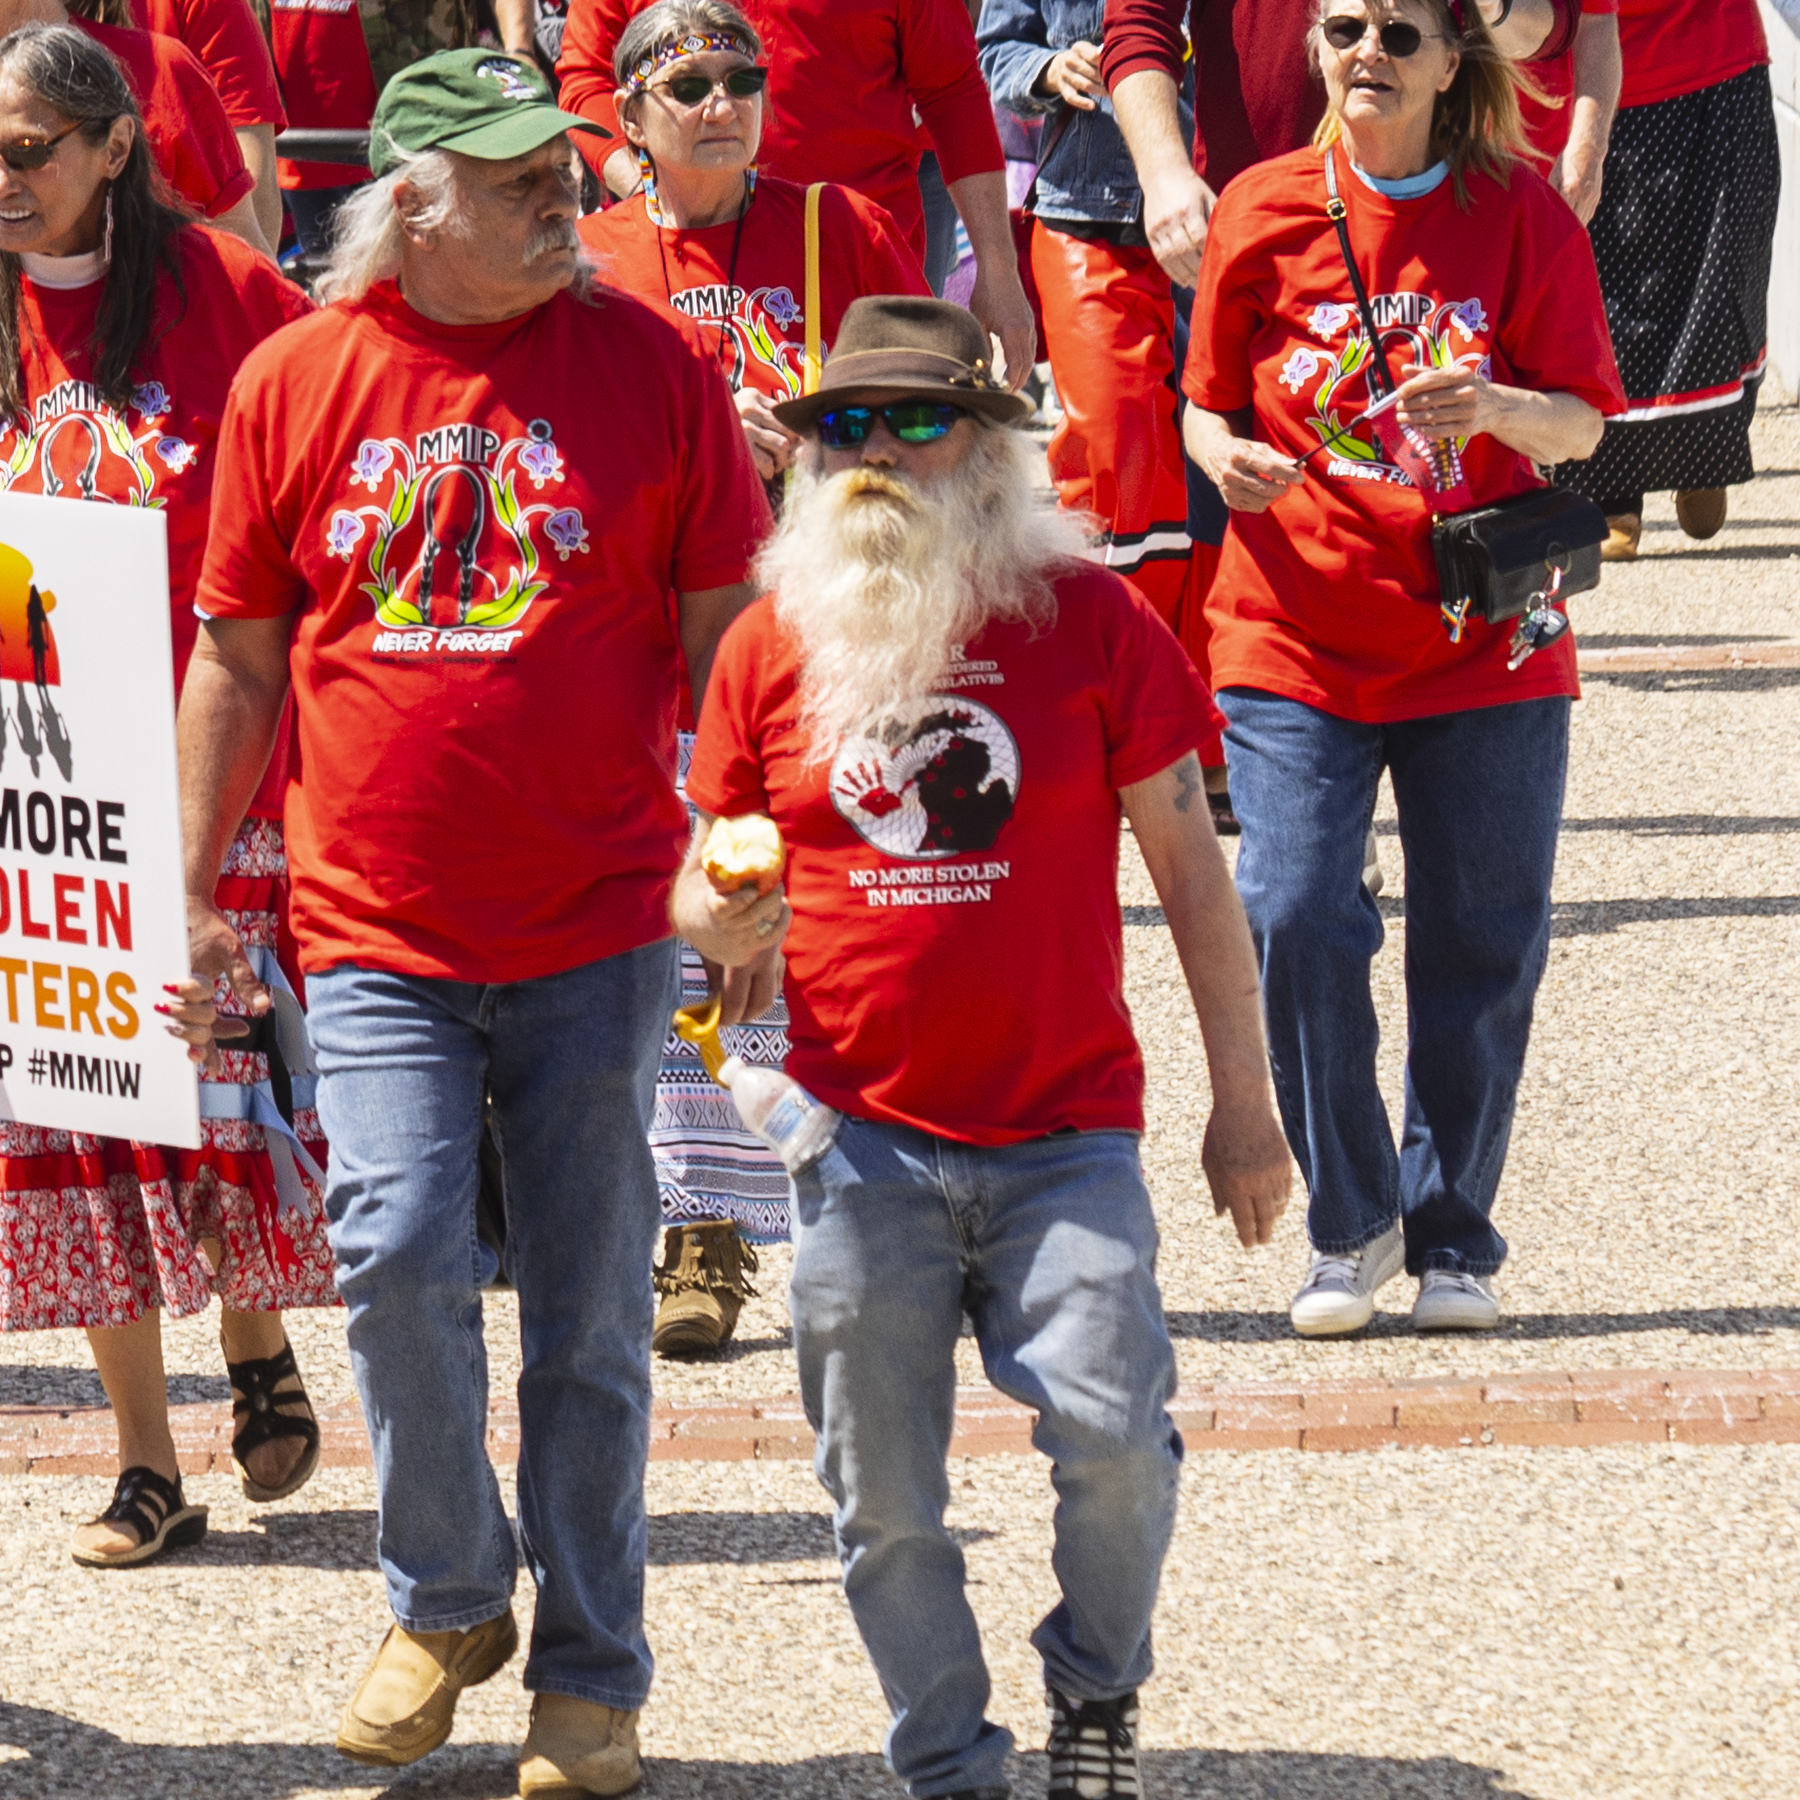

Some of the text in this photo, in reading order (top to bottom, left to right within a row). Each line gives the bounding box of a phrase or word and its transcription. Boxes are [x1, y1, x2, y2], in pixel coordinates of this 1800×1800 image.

[670, 284, 746, 318] MMIP
[416, 422, 501, 465] MMIP
[1327, 459, 1385, 482] NEVER
[372, 629, 524, 654] NEVER FORGET
[848, 860, 1011, 888] NO MORE STOLEN
[866, 884, 992, 907] IN MICHIGAN
[27, 1048, 142, 1100] #MMIW
